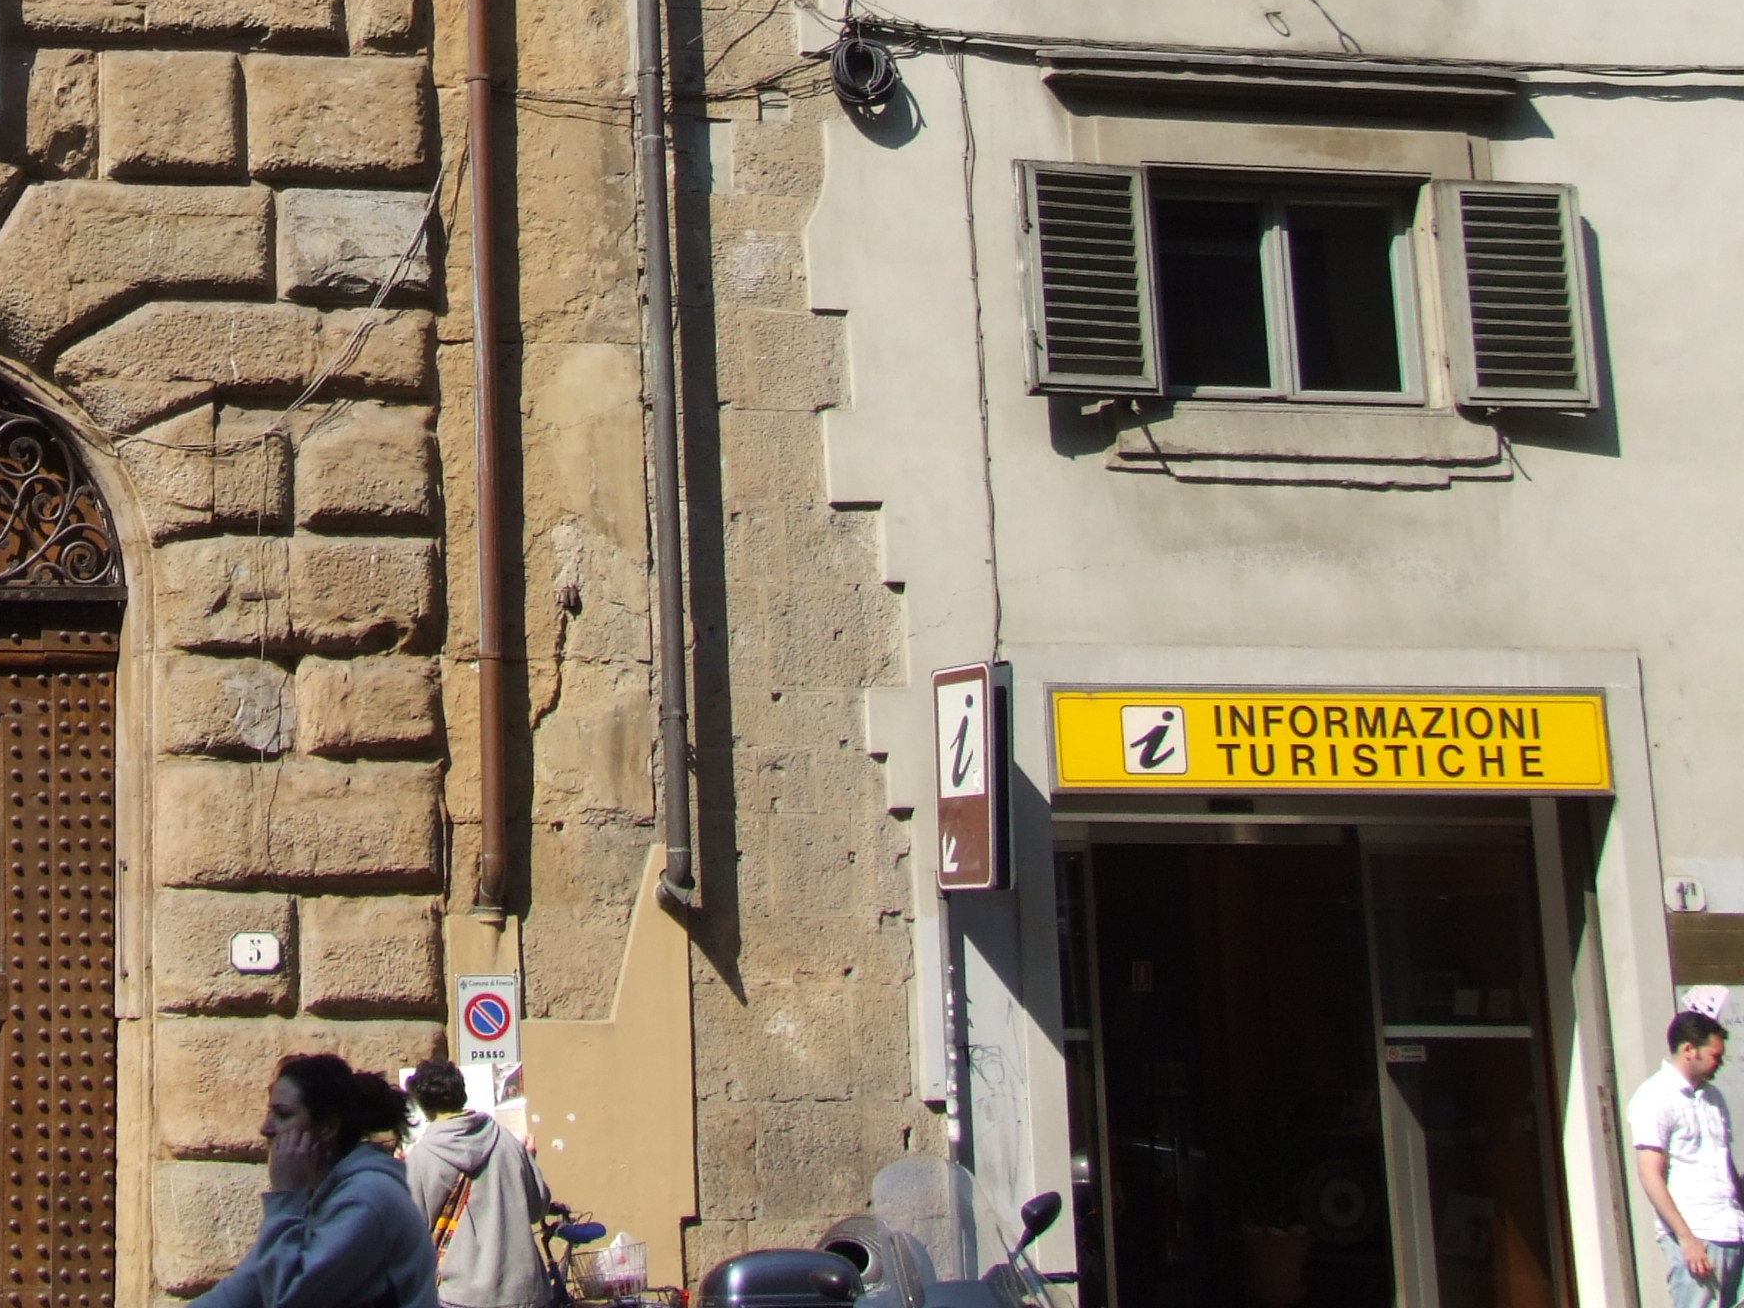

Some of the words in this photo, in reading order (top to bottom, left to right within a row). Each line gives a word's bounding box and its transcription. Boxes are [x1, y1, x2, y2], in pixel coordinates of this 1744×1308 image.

[1212, 704, 1542, 740] INFORMAZIONI
[1216, 743, 1545, 778] TURISTICHE
[249, 939, 262, 964] 5
[471, 1050, 506, 1061] passo
